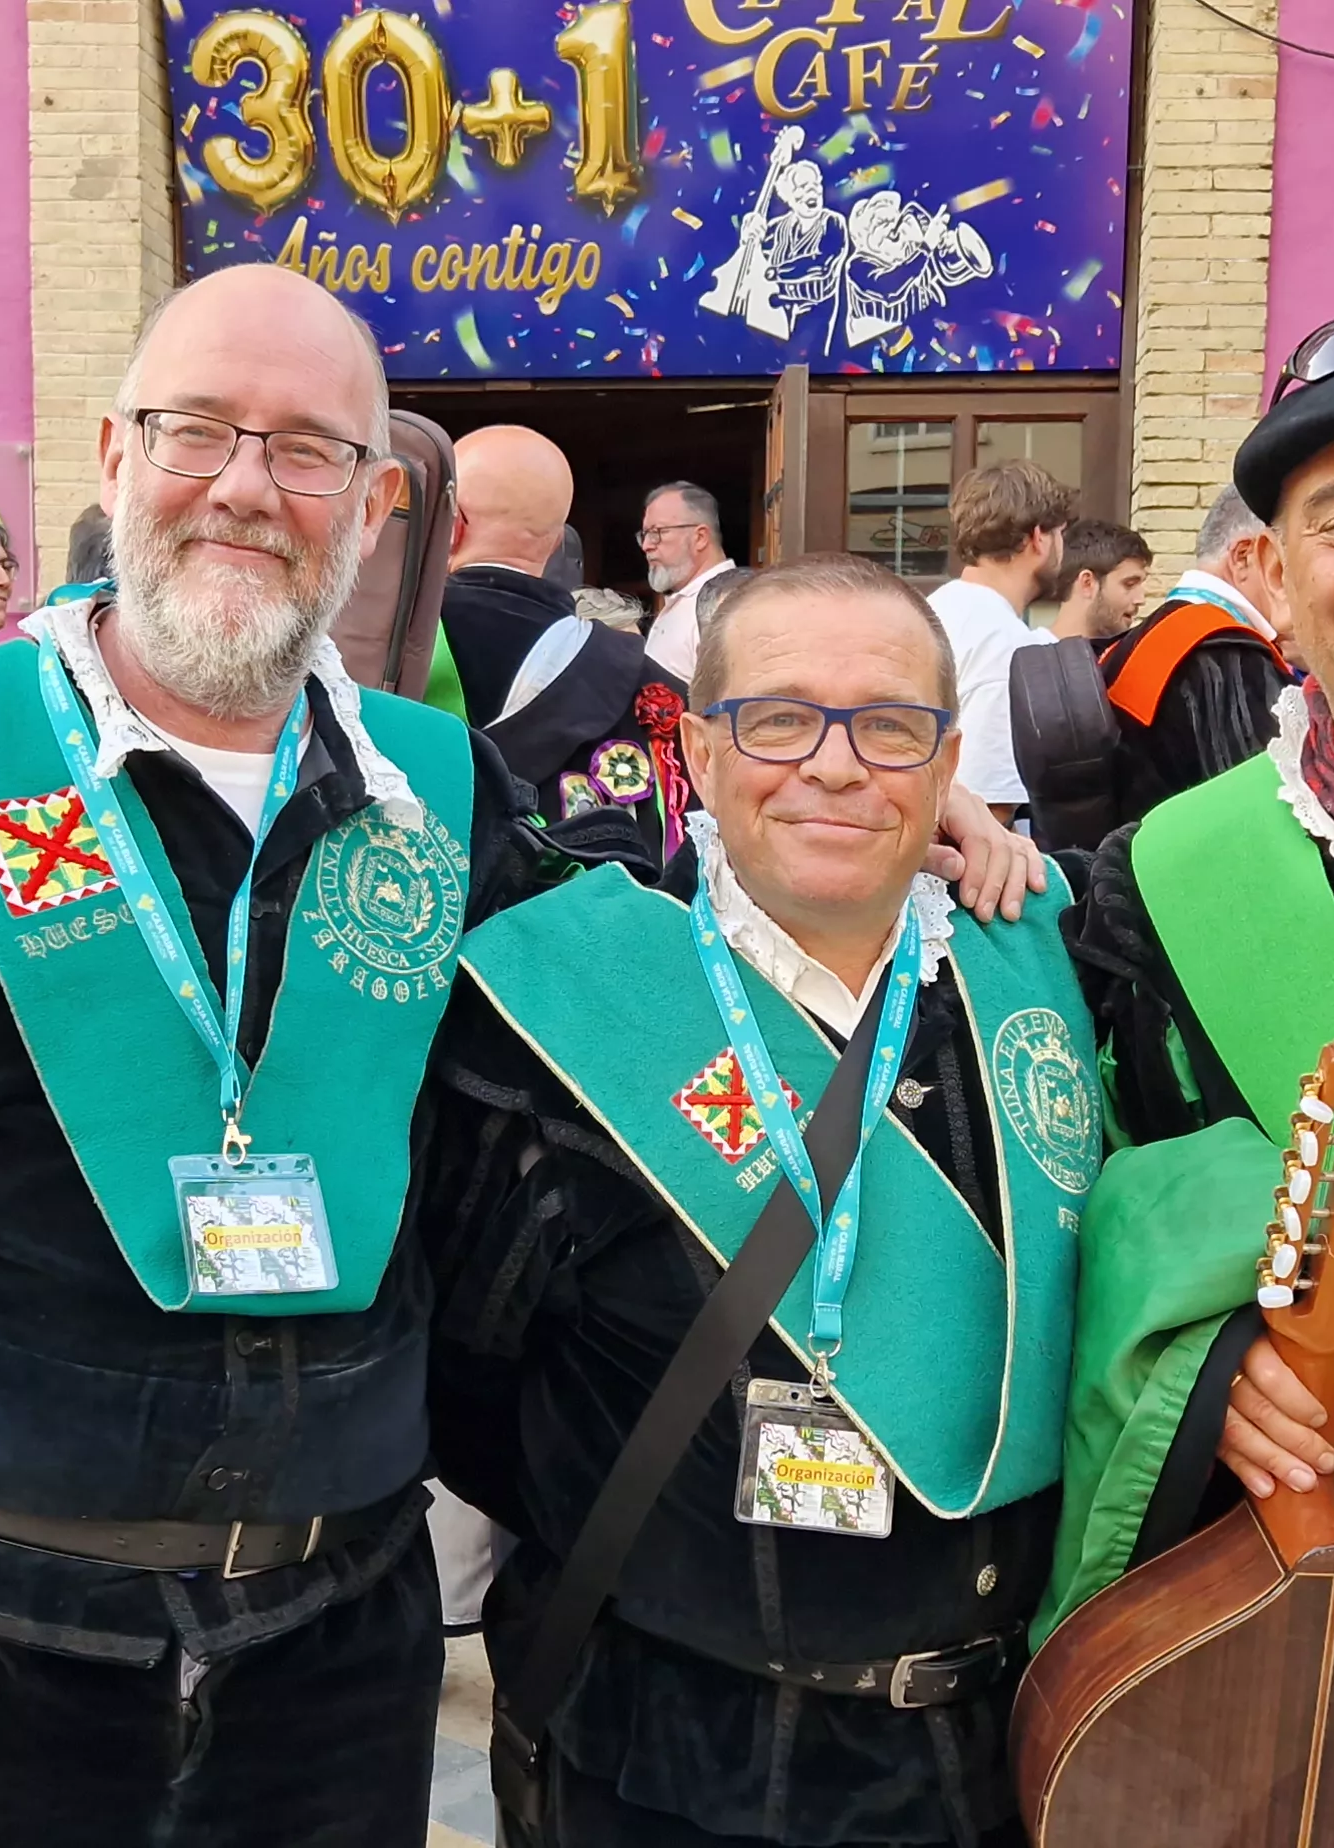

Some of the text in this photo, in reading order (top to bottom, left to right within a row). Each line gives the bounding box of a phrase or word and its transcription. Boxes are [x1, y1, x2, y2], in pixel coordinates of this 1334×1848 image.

[754, 27, 939, 119] CAFÉ
[190, 4, 643, 224] 30+1
[275, 215, 601, 316] Años contigo
[110, 826, 139, 875] CAJA RURAL
[320, 840, 343, 908] TUNA
[149, 911, 179, 961] CAJA RURAL
[341, 922, 411, 968] HUESCA
[710, 961, 735, 1007] CAJA RURAL
[893, 987, 908, 1028] CAJA RURAL
[191, 997, 221, 1047] CAJA RURAL
[742, 1042, 766, 1090] CAJA RURAL
[872, 1062, 892, 1107] CAJA RURAL
[1000, 1067, 1030, 1138] TUNA
[774, 1127, 801, 1176] CAJA RURAL
[206, 1229, 302, 1247] Organización
[832, 1231, 848, 1283] CAJA RURAL
[776, 1463, 875, 1486] Organización
